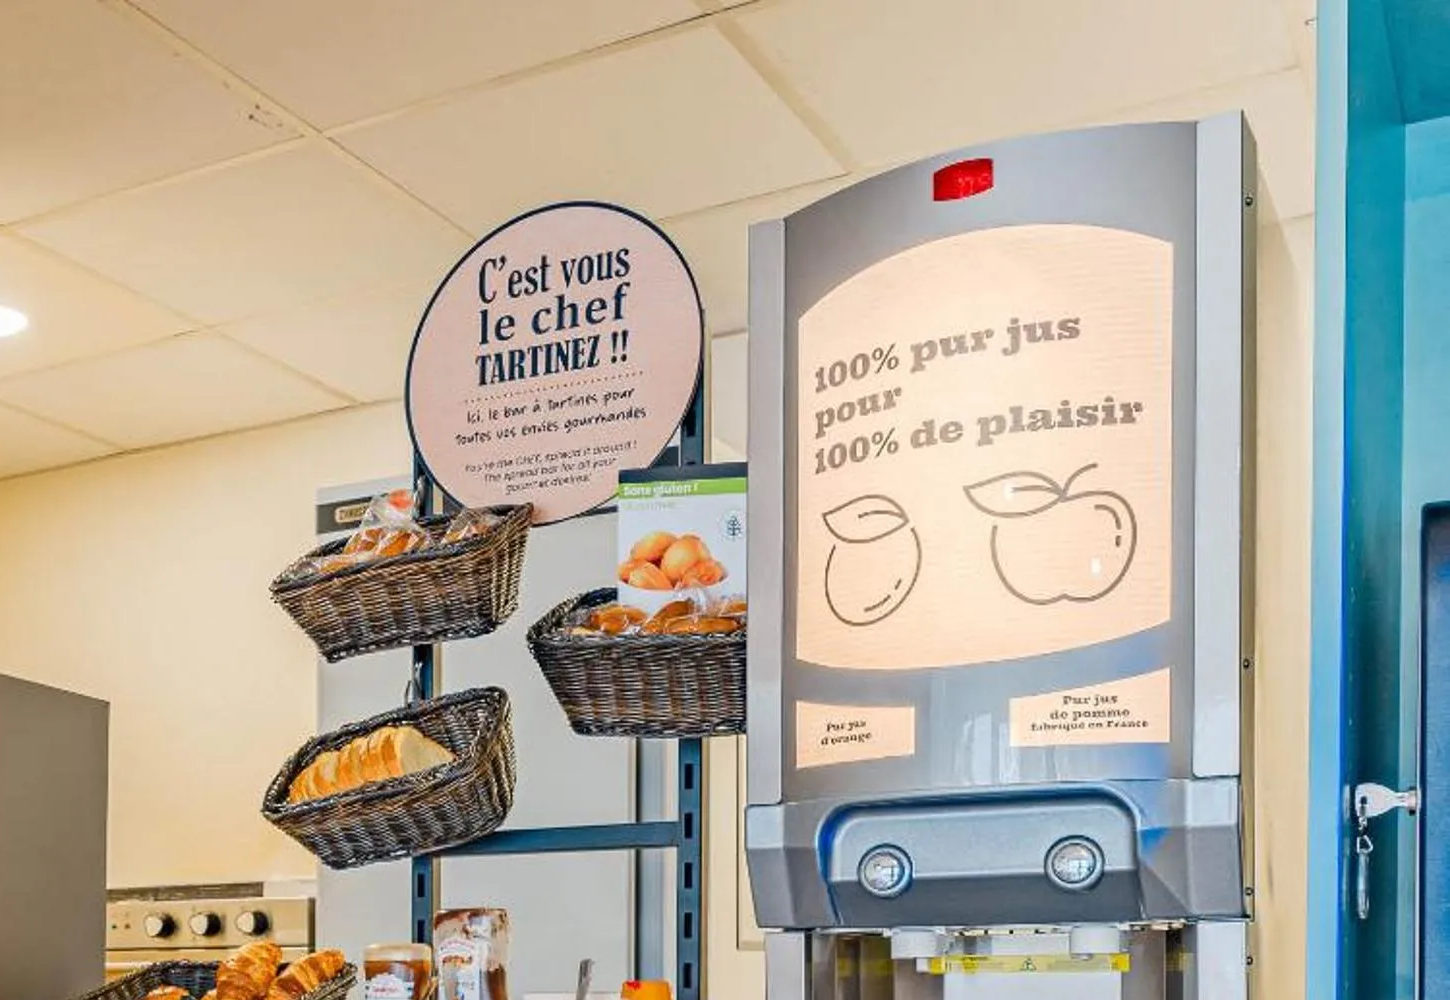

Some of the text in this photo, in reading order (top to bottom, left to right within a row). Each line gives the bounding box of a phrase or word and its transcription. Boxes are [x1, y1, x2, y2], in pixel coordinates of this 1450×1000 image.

[478, 248, 630, 304] C'est vous
[479, 282, 630, 345] le chef
[475, 330, 628, 386] TARTINEZ !!
[814, 316, 1081, 393] 100% pur jus
[489, 409, 498, 421] le
[504, 406, 527, 418] bar
[604, 388, 635, 407] pour
[521, 419, 559, 436] envies
[564, 405, 647, 433] gourmandes
[814, 387, 902, 440] pour
[814, 396, 1143, 474] 100% de plaisir
[1049, 708, 1131, 721] de pomme
[1063, 694, 1119, 706] Pur jus
